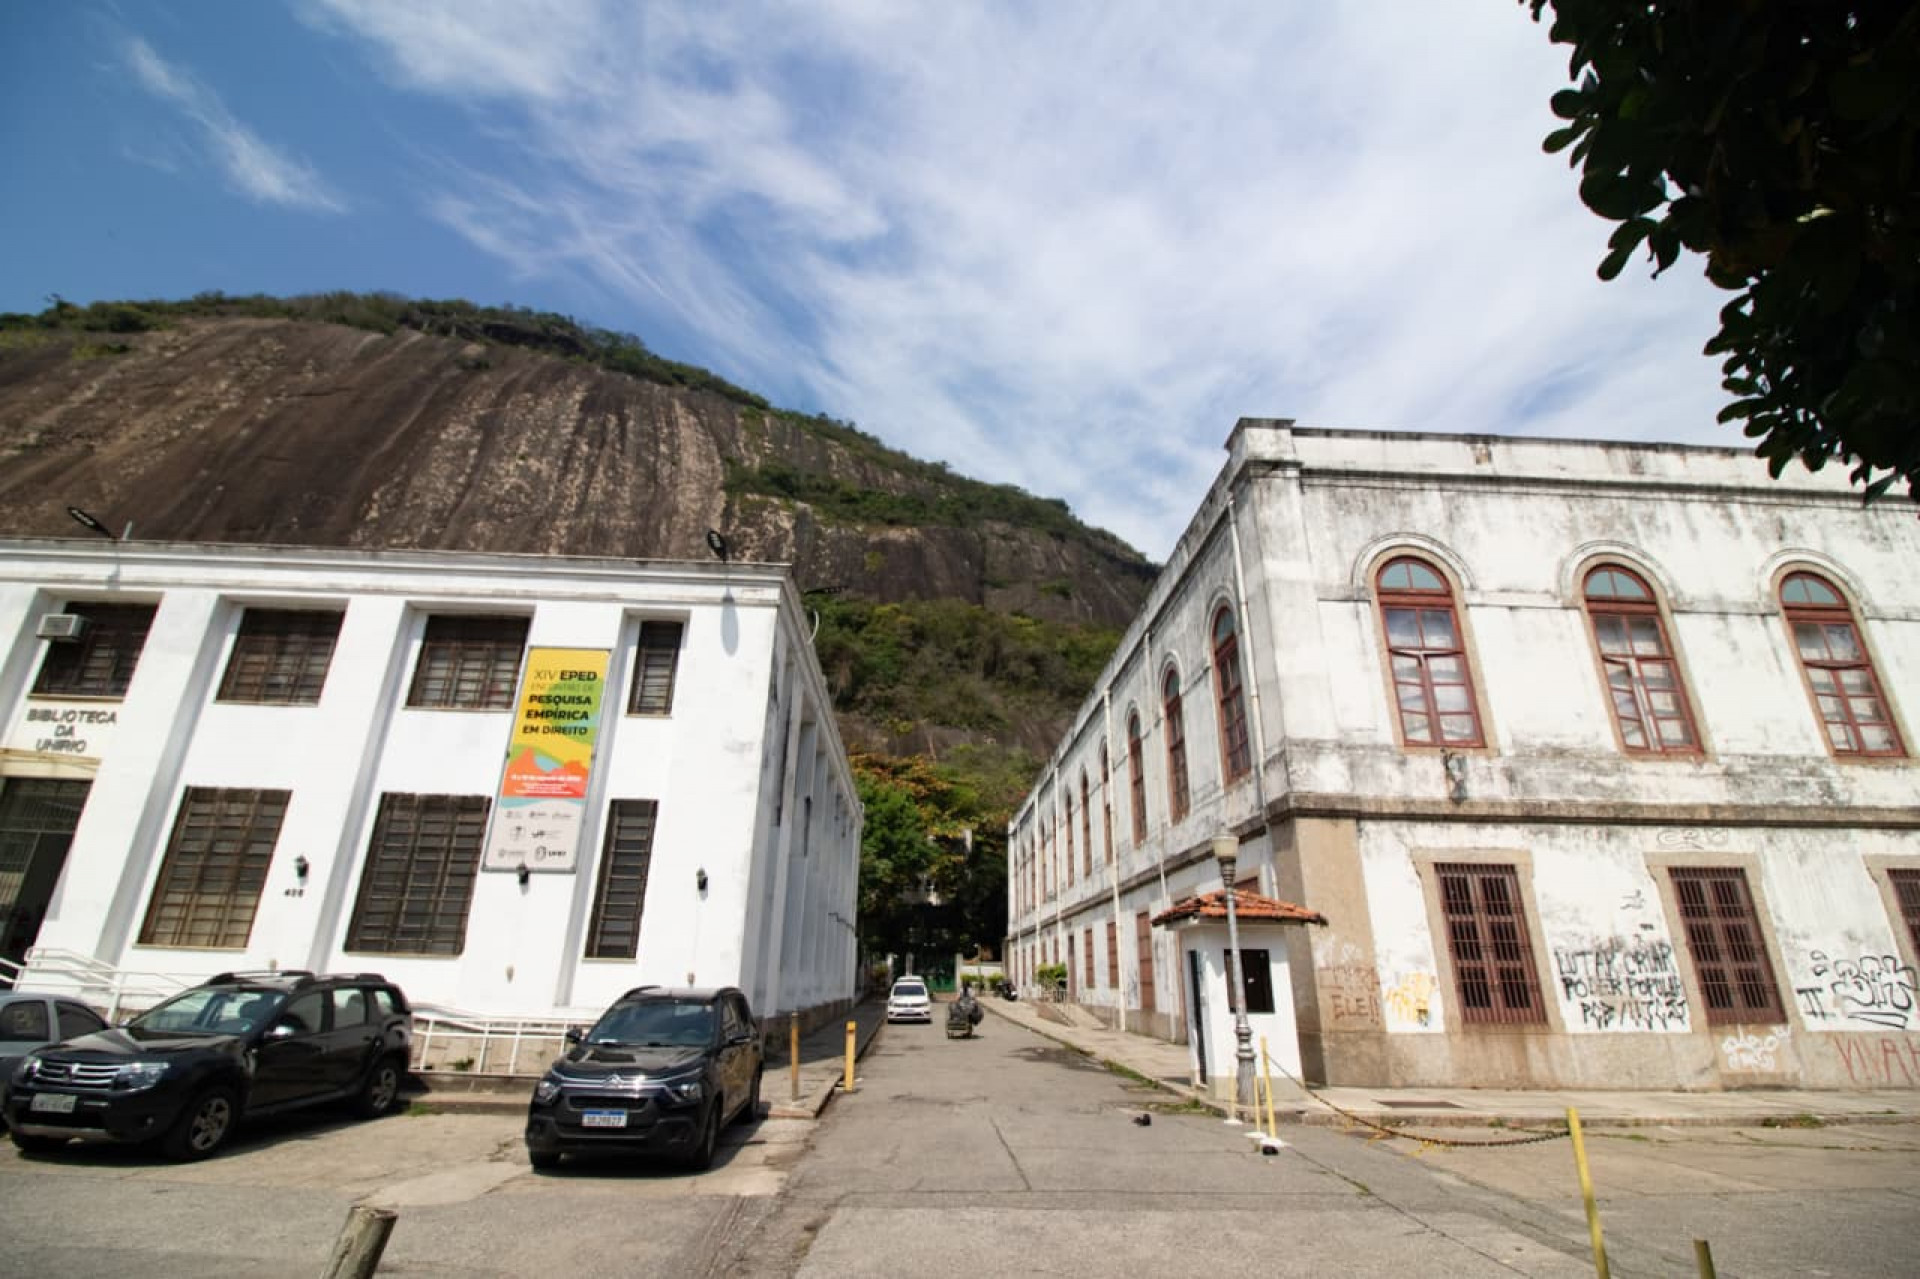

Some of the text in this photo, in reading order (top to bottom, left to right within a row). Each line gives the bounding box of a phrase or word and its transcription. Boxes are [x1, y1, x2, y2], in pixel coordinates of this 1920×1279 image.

[533, 670, 597, 681] XIV EPED
[528, 694, 592, 706] PESQUISA
[27, 708, 117, 724] BIBLIOTECA
[526, 706, 588, 720] EMPÍRICA
[54, 724, 75, 737] DA
[522, 724, 588, 736] EM DIREITO
[35, 738, 87, 753] UNIRIO
